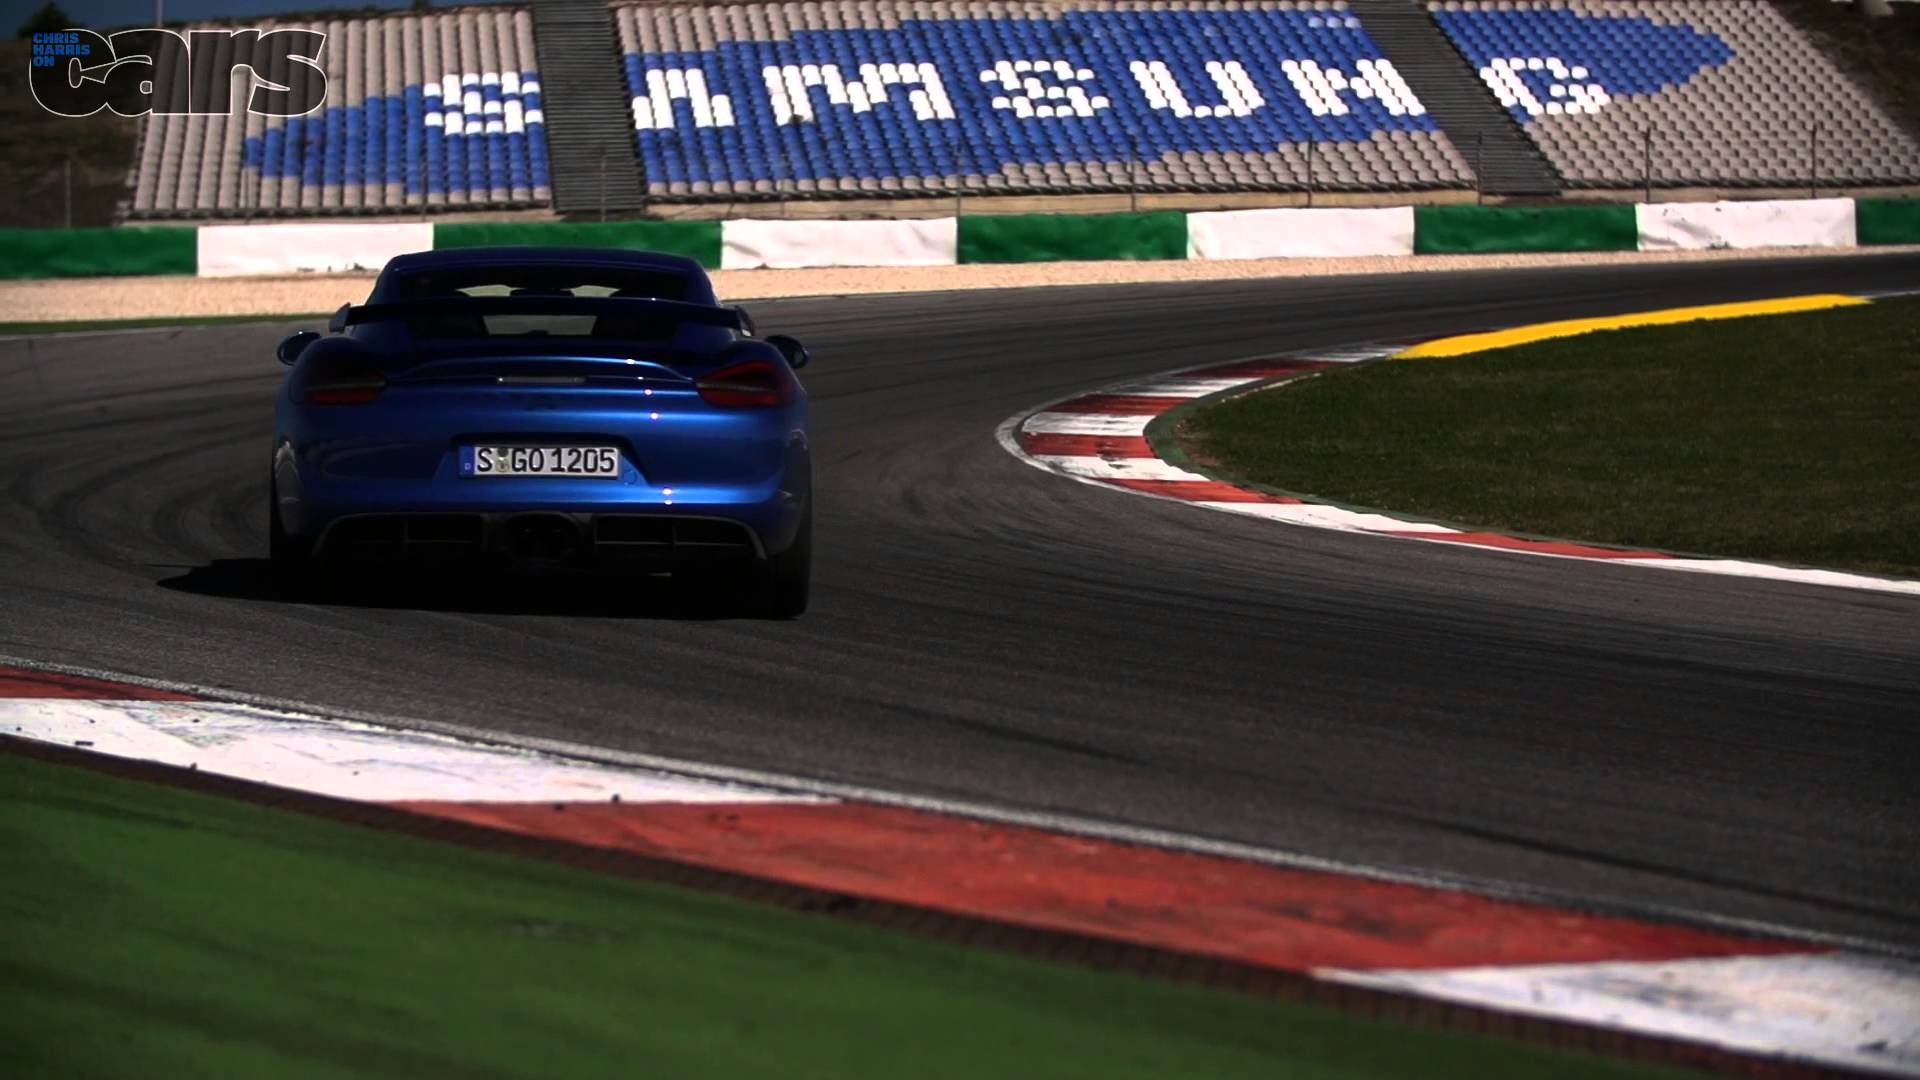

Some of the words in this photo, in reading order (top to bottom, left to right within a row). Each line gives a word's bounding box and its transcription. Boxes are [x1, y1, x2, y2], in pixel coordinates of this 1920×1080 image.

[423, 57, 1611, 135] SAMSUNG
[477, 448, 493, 472] S
[511, 448, 544, 472] GO
[551, 448, 615, 472] 1205
